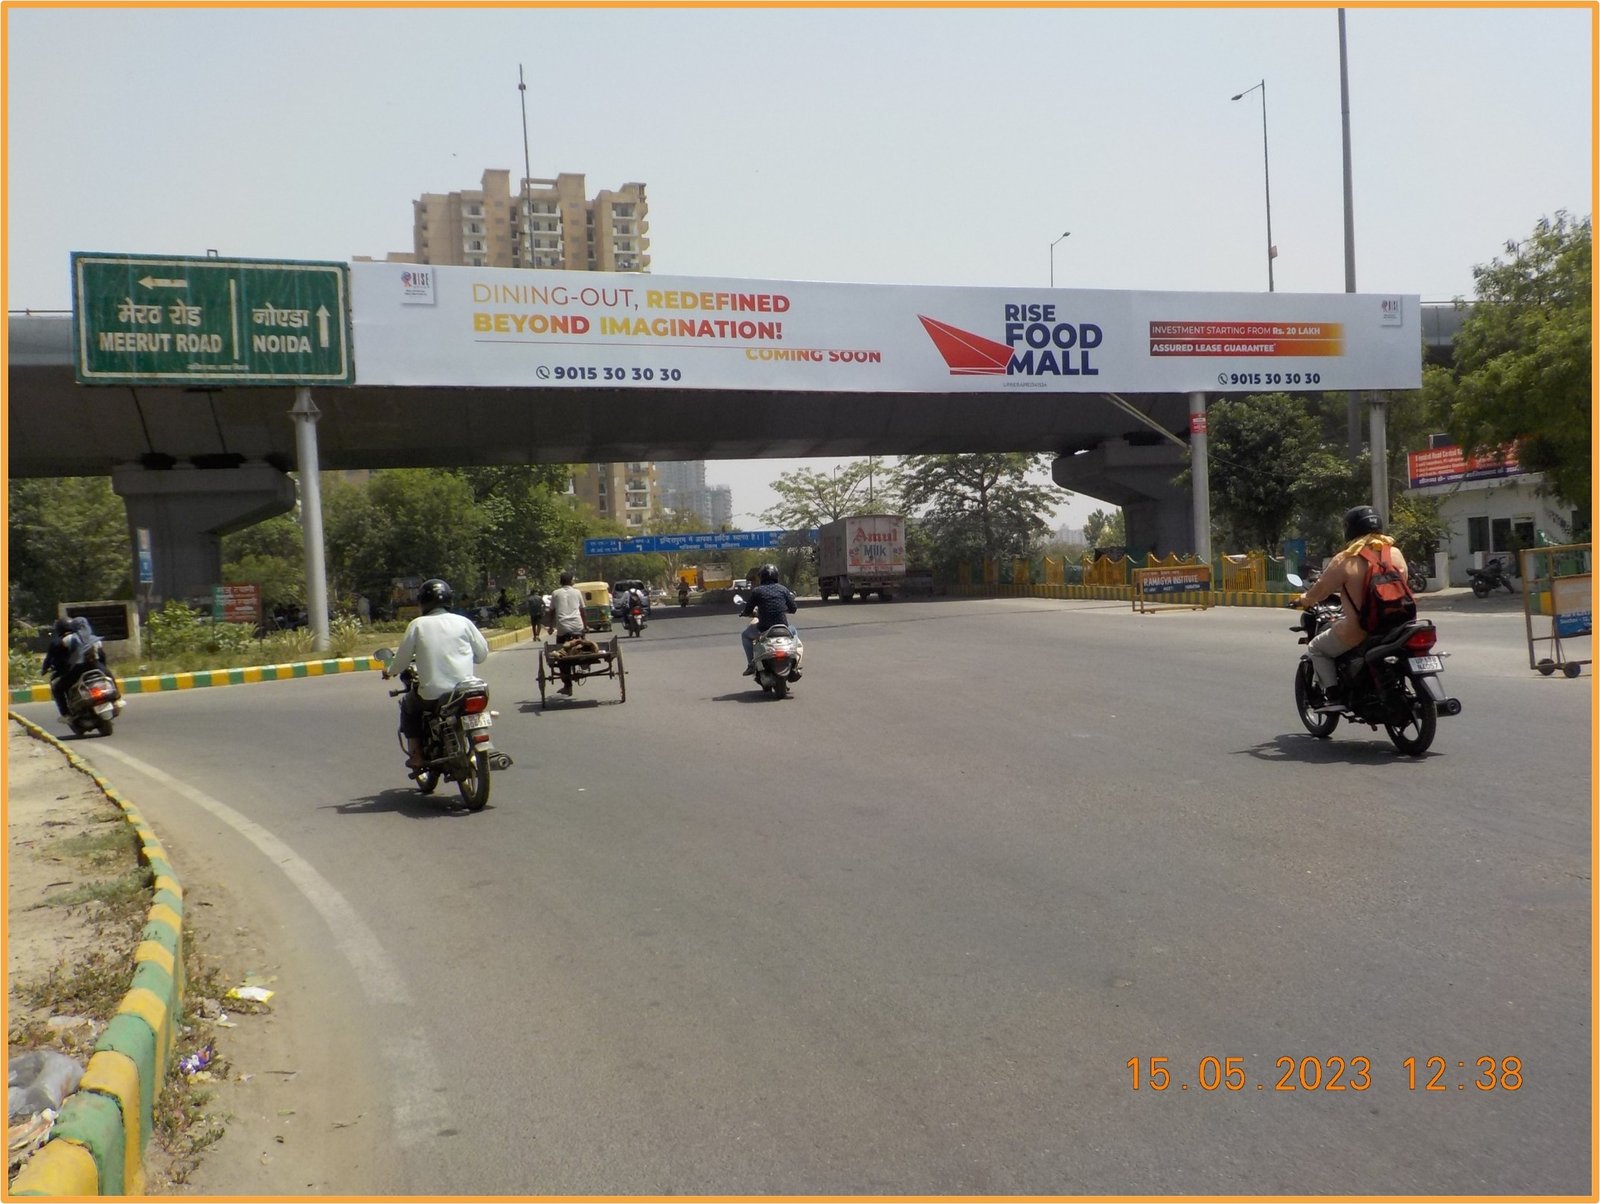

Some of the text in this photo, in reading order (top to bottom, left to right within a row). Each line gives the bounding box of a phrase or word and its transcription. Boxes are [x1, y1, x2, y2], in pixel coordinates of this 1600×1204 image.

[473, 284, 790, 313] DINING-OUT, REDEFINED
[117, 298, 202, 327] मेरठ रोड
[252, 302, 309, 327] नोएडा
[1005, 304, 1056, 322] RISE
[473, 312, 782, 340] BEYOND IMAGINATION!
[1152, 326, 1204, 335] INVESTMENT
[1207, 327, 1245, 335] STARTING
[1248, 327, 1270, 335] FROM
[1272, 327, 1285, 335] Rs.
[99, 332, 222, 353] MEERUT ROAD
[253, 335, 312, 354] NOIDA
[1005, 323, 1103, 349] FOOD
[745, 348, 881, 363] COMING SOON
[1152, 344, 1193, 352] ASSURED
[1195, 344, 1222, 352] LEASE
[1007, 350, 1099, 375] MALL
[553, 366, 682, 382] 9015 30 30 30
[1230, 373, 1321, 385] 9015 30 30 30
[853, 528, 898, 543] Amul
[864, 545, 886, 556] Milk
